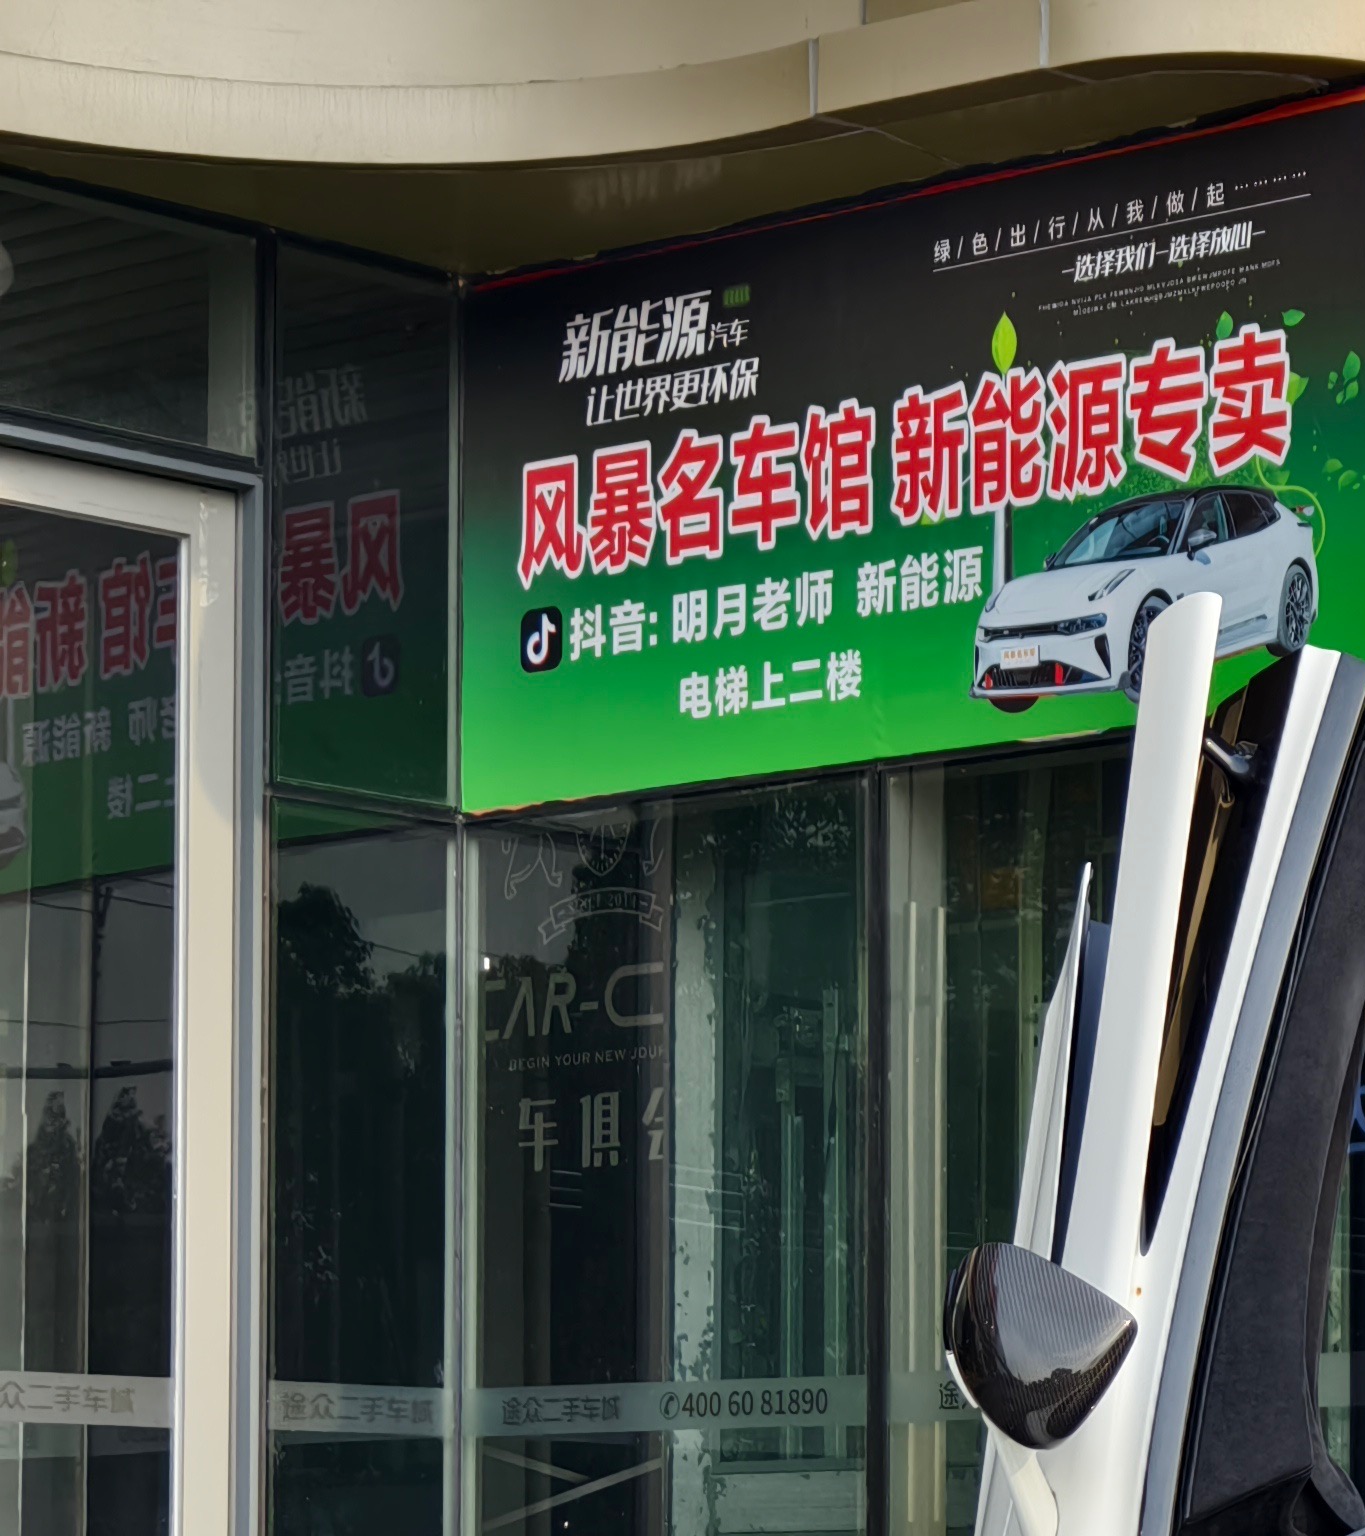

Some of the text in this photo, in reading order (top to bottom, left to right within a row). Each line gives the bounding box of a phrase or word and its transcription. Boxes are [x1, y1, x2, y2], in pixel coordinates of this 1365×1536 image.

[586, 357, 760, 427] 让世界更环保
[516, 323, 1292, 590] 风暴名车馆 新能源专卖
[856, 545, 984, 617] 新能源
[679, 649, 863, 720] 电梯上二楼
[555, 1052, 590, 1066] YOUR
[682, 1391, 721, 1418] 400
[728, 1390, 754, 1417] 60
[760, 1388, 828, 1415] 81890
